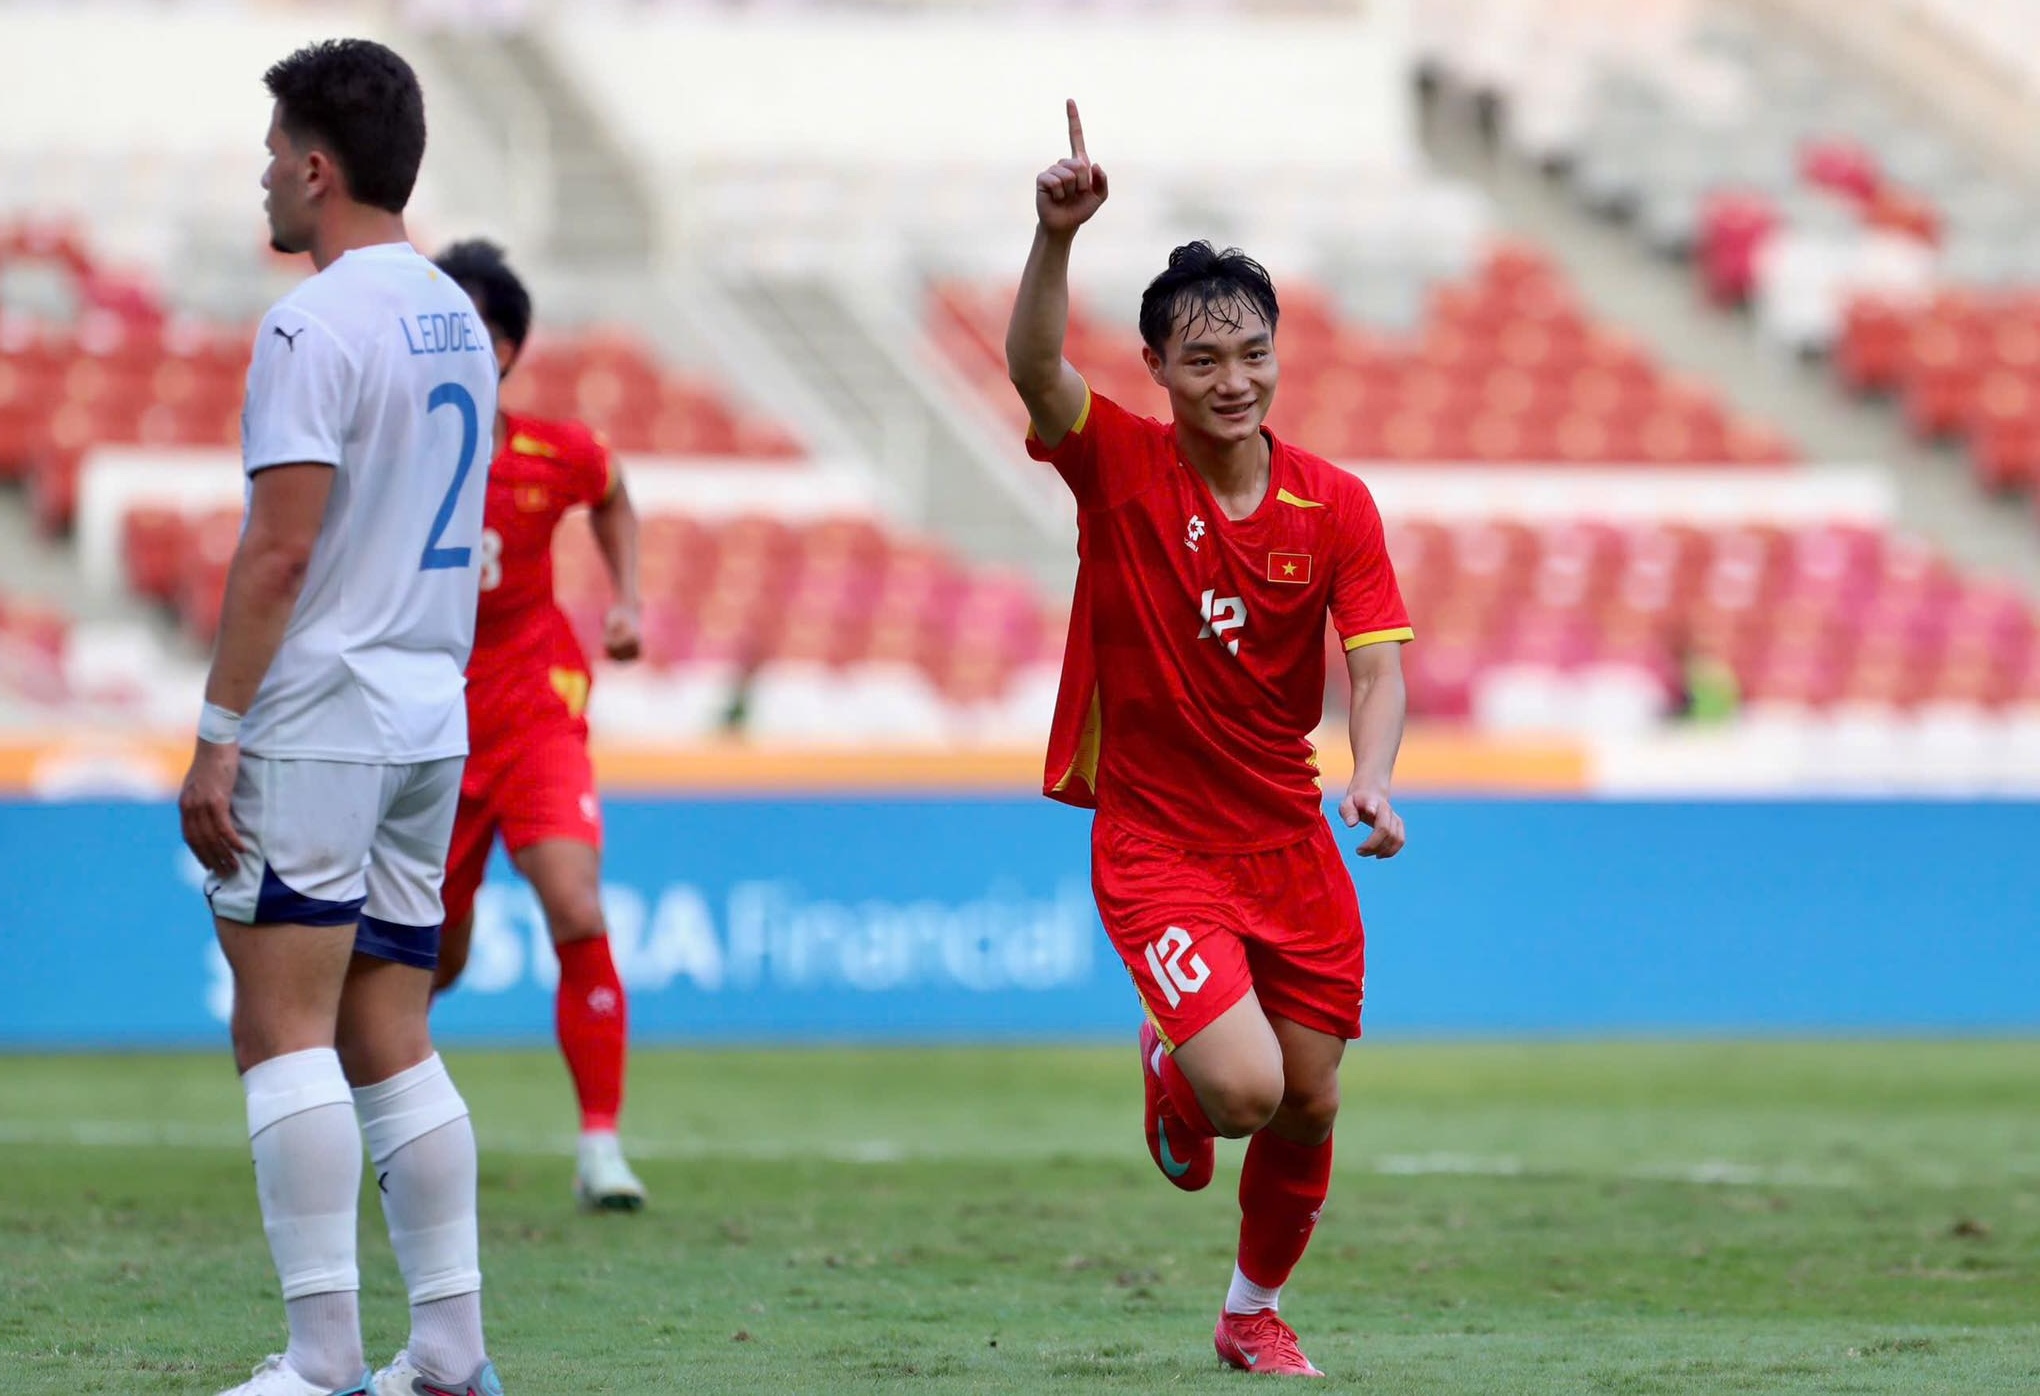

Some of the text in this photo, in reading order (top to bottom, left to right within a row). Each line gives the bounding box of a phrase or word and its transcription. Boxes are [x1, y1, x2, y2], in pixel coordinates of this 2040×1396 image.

[419, 382, 479, 572] 2
[1197, 588, 1248, 657] 12
[1144, 925, 1211, 1010] 12
